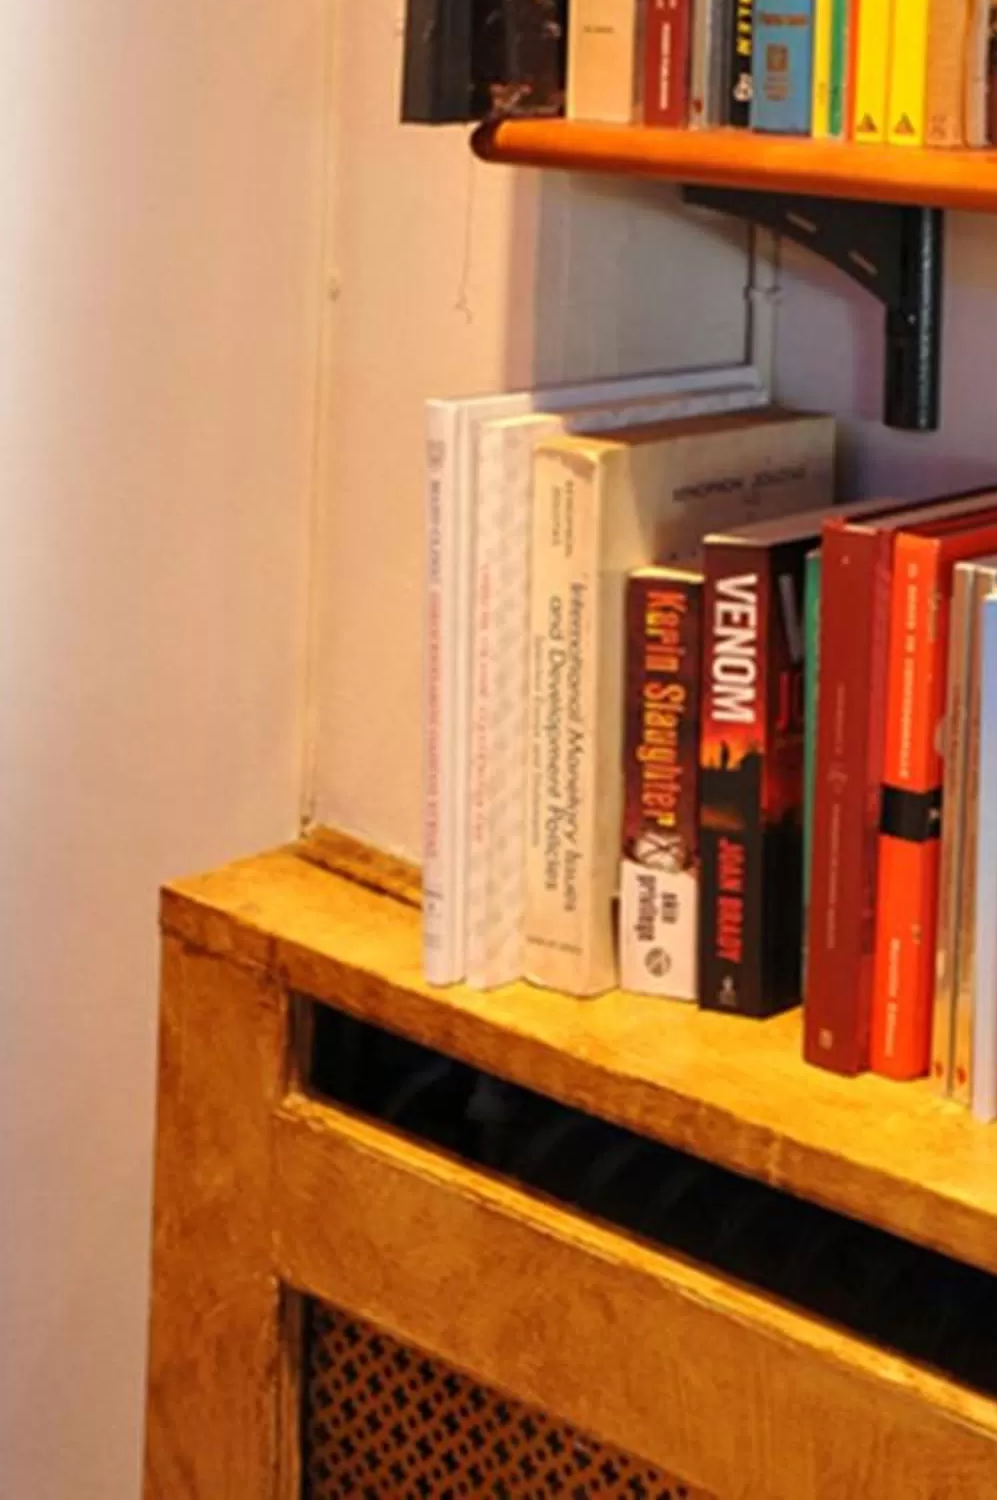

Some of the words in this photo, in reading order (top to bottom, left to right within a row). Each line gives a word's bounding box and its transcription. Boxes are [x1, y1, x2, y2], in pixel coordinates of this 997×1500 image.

[644, 589, 686, 672] Karin
[711, 574, 758, 725] VENOM
[638, 682, 686, 827] Slaughter
